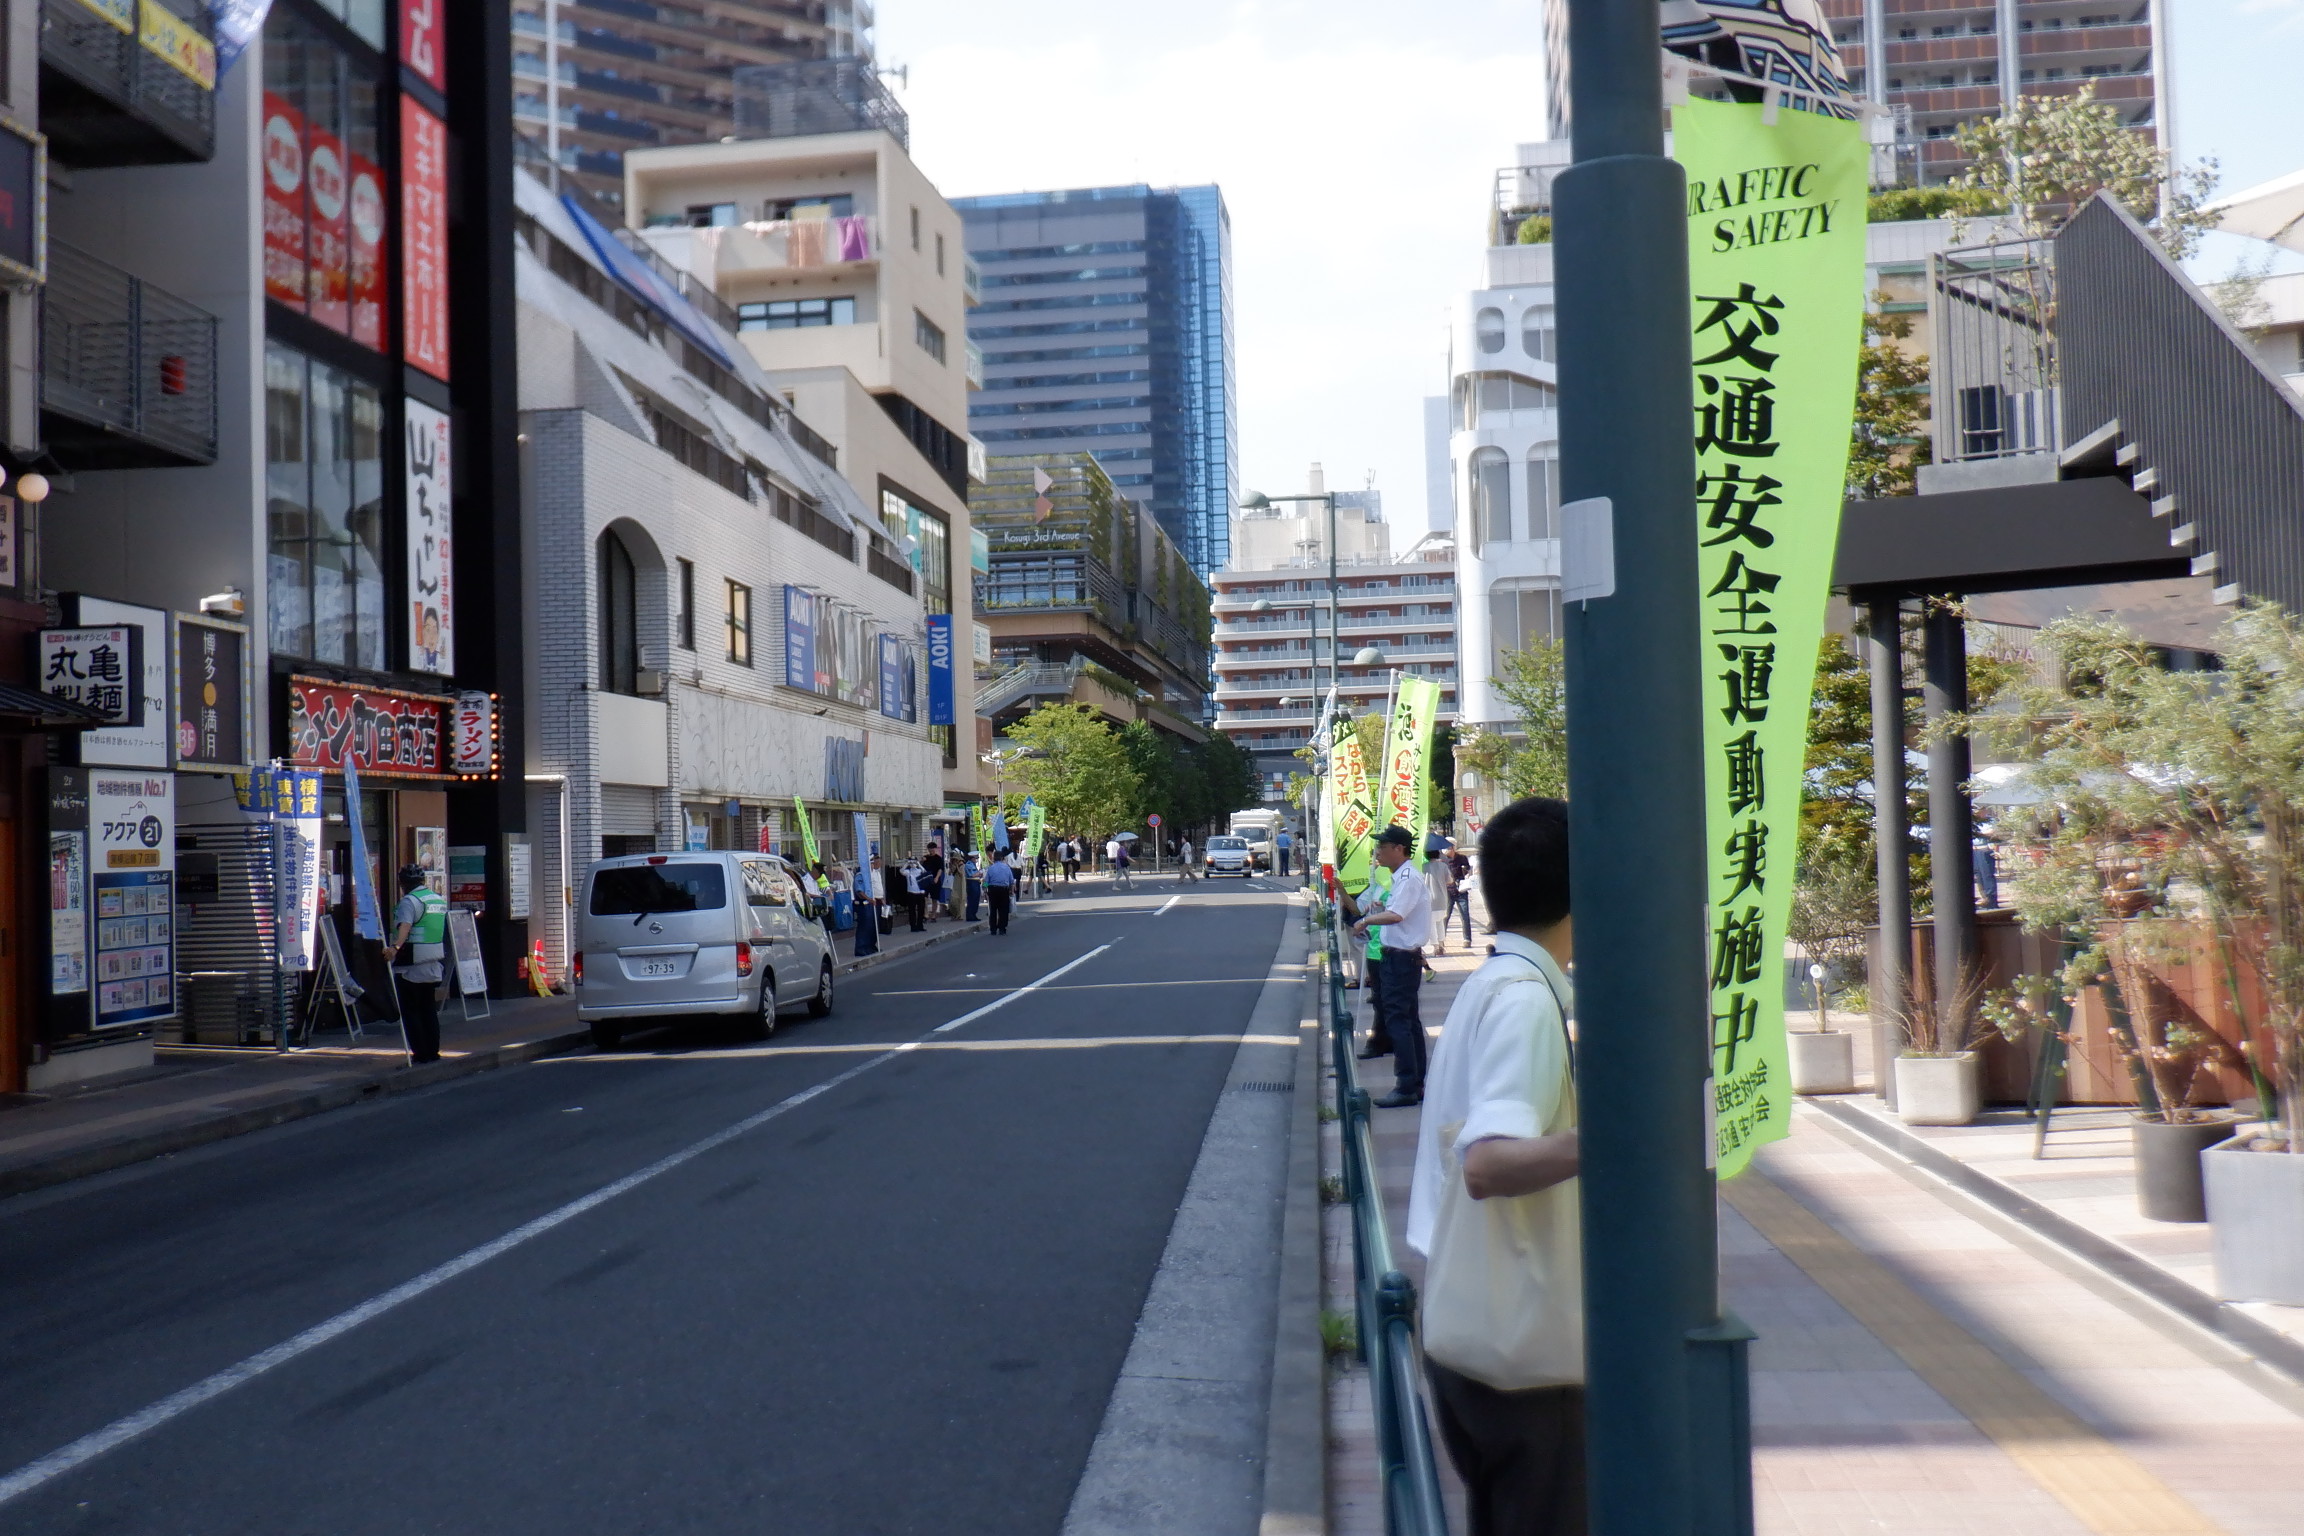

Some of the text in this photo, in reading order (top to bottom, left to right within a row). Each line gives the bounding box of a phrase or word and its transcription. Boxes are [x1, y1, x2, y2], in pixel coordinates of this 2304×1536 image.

[1712, 199, 1840, 253] SAFETY
[408, 418, 438, 597] 山ちゃん
[1004, 529, 1080, 546] Kosugi 3rd Avenue
[791, 592, 809, 627] AOKI
[46, 645, 122, 682] 丸亀
[204, 631, 216, 680] 博多
[931, 626, 949, 669] AOKI
[1692, 281, 1784, 1076] 交通安全運動実施中
[179, 728, 195, 750] 3F
[204, 707, 217, 758] 満月
[459, 711, 482, 762] ラーメン
[144, 779, 167, 798] No.1
[1334, 756, 1350, 806] スマホ
[103, 822, 159, 842] アクア 21
[648, 963, 674, 974] 97-39
